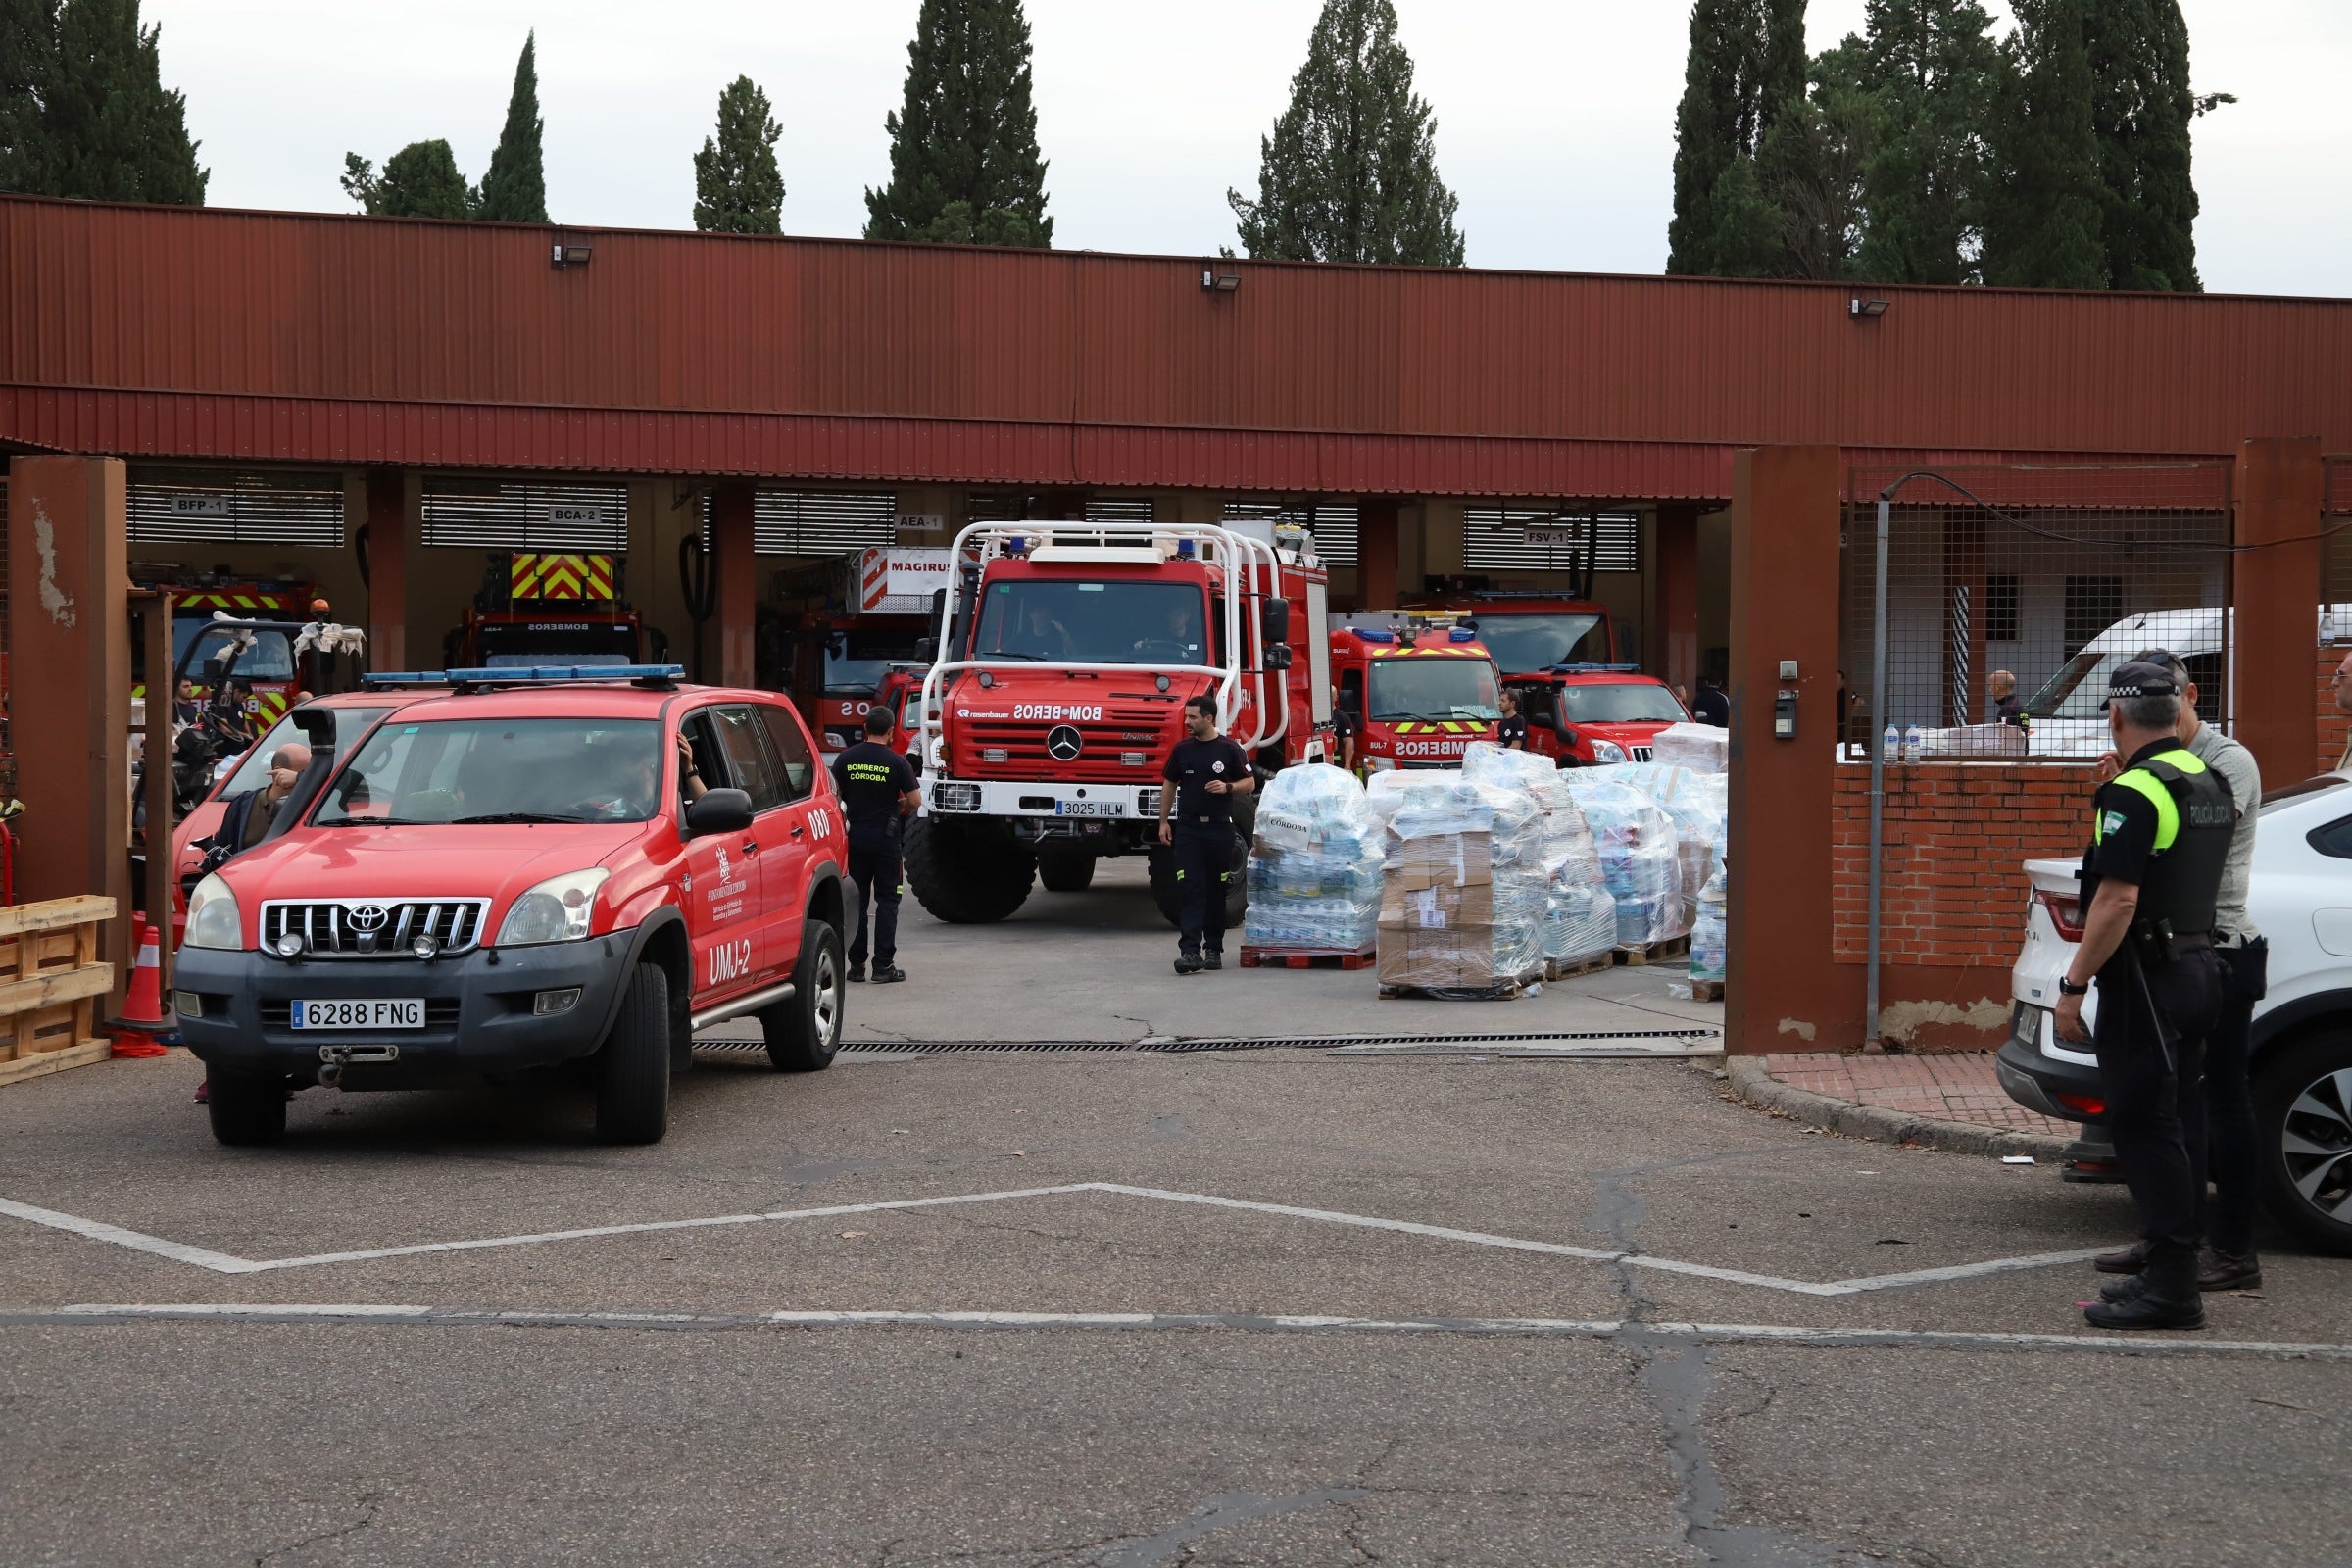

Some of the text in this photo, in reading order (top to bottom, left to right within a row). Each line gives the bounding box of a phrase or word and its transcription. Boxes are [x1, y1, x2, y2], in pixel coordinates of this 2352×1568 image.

[555, 510, 595, 520] BCA-2
[900, 516, 938, 527] AEA-1
[847, 763, 890, 774] BOMBEROS
[1065, 803, 1123, 816] 3025 HLM
[808, 808, 830, 841] 080
[710, 938, 751, 986] UMJ-2
[308, 1003, 368, 1026] 6288
[374, 1003, 419, 1025] FNG
